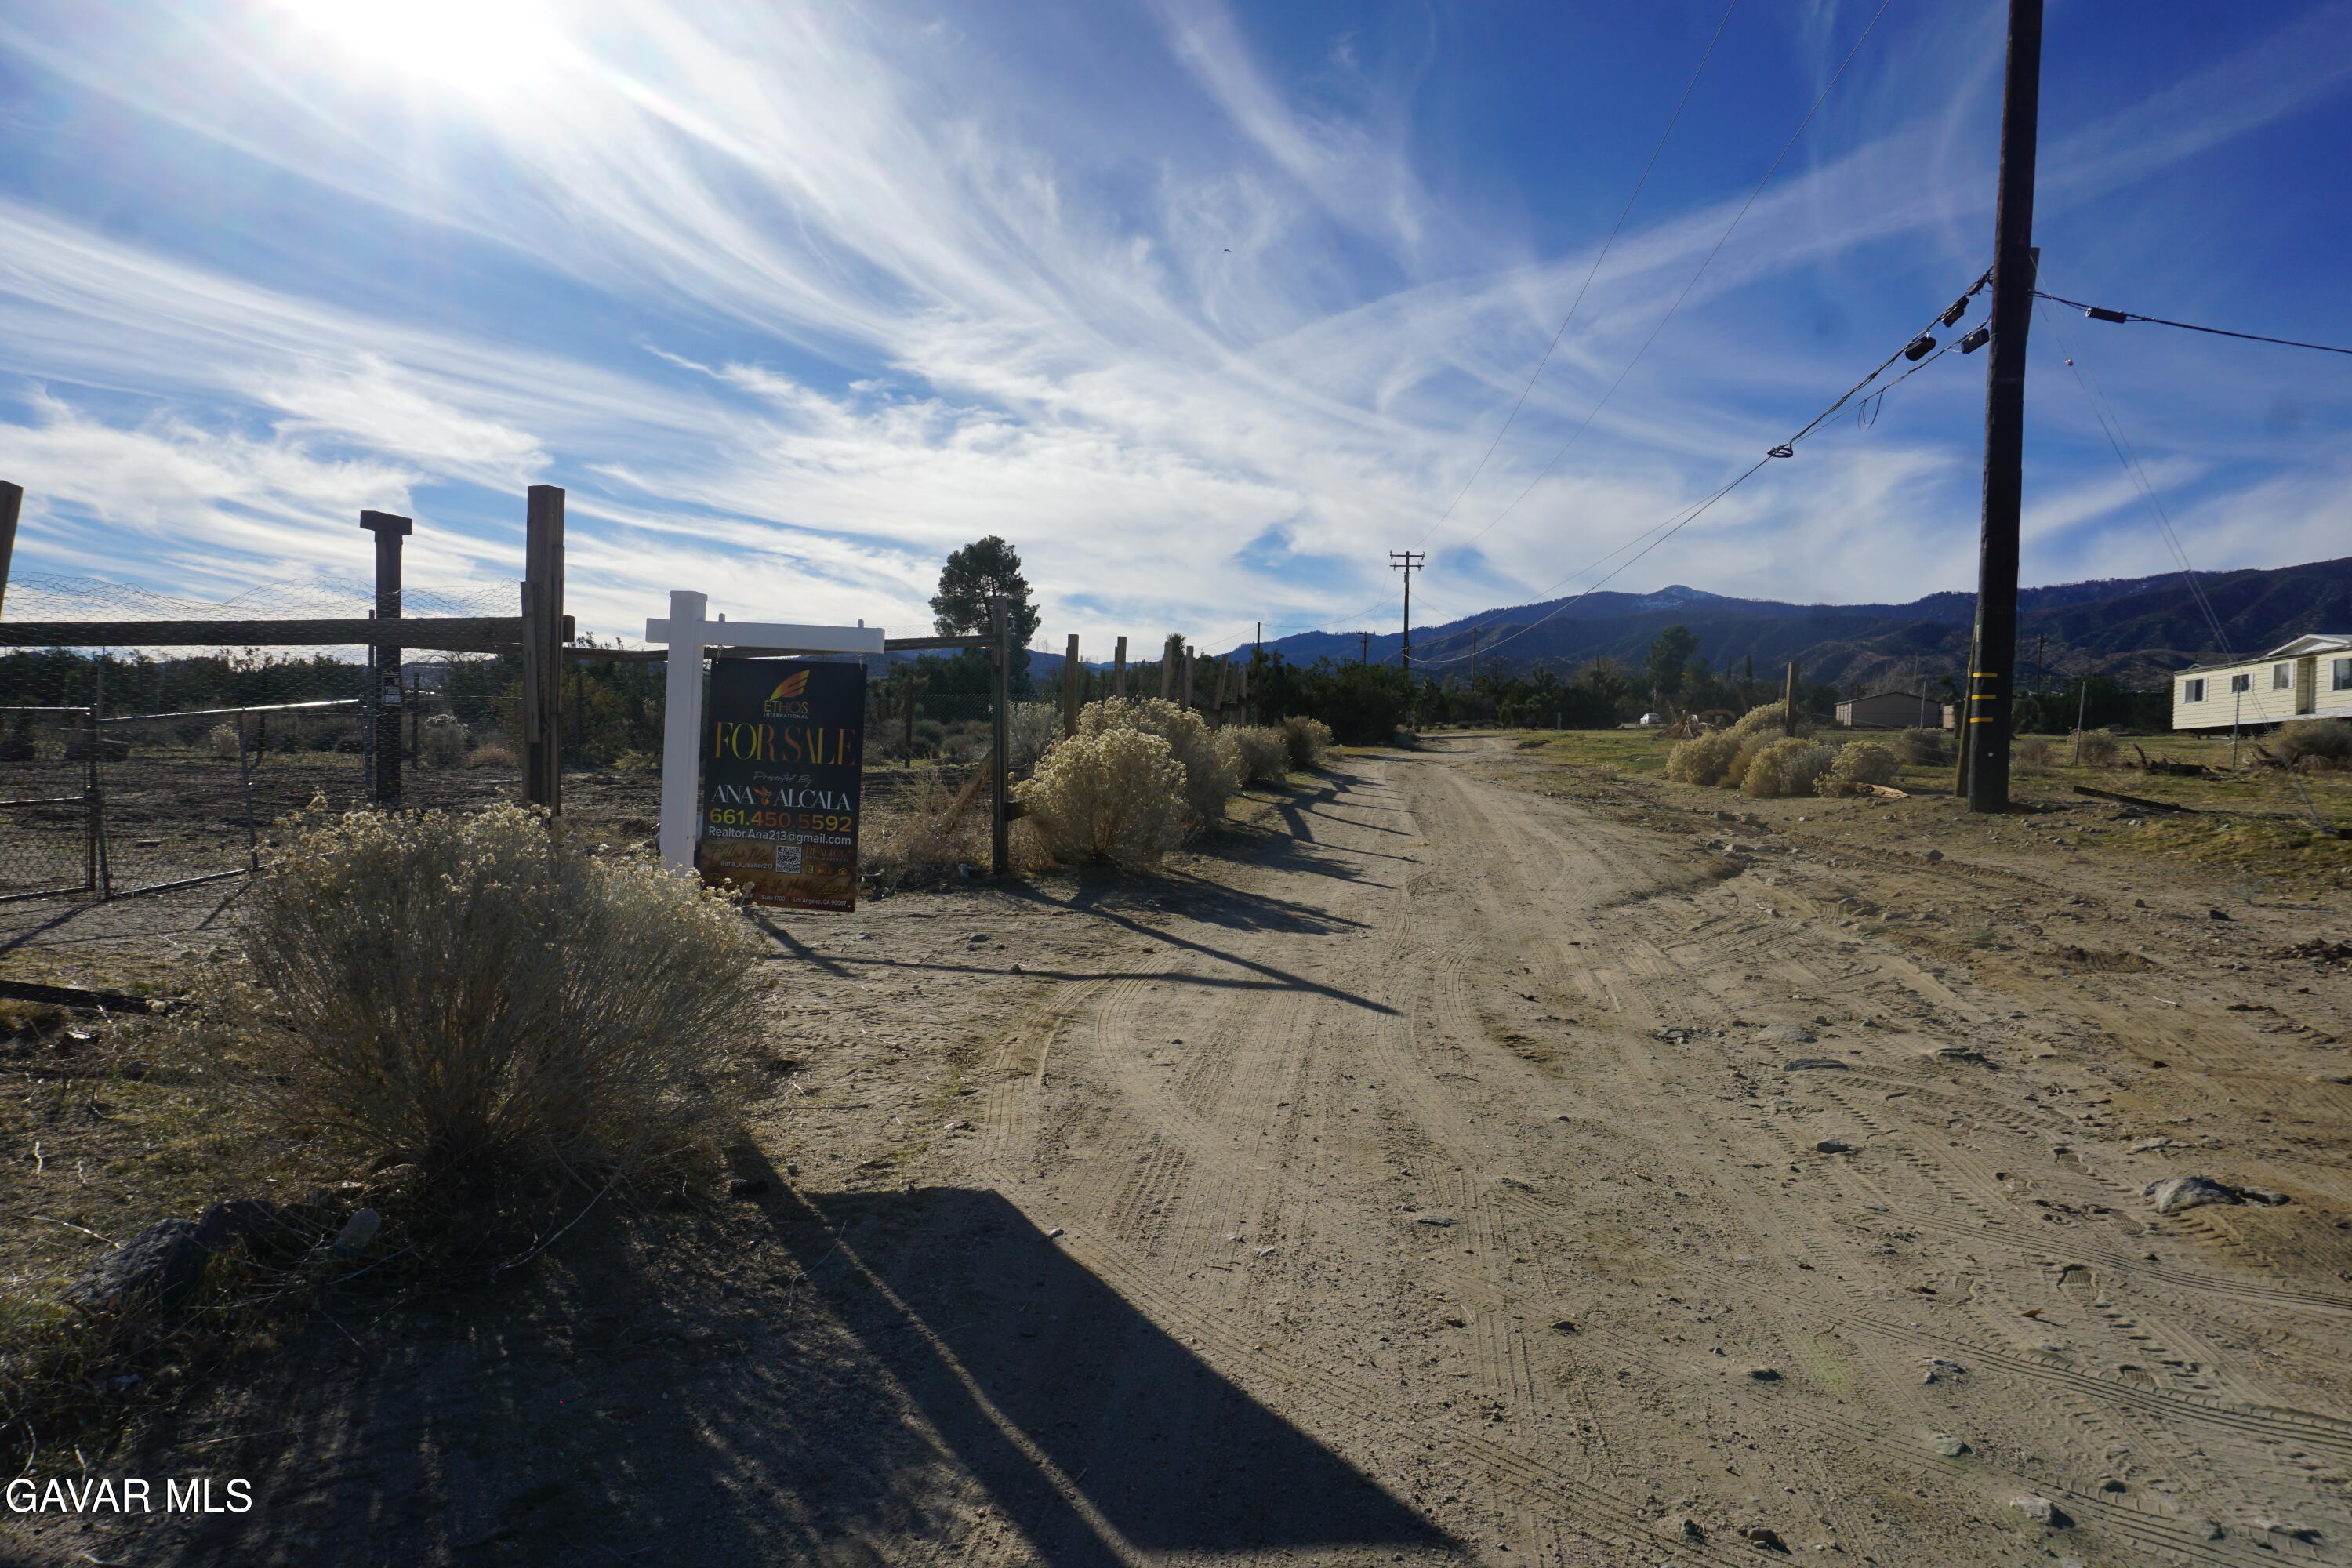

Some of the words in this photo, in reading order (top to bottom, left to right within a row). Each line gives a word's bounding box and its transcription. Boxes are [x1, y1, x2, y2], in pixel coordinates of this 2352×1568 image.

[764, 700, 809, 714] ETHOS
[715, 721, 777, 762] FOR
[783, 727, 857, 766] SALE
[710, 784, 757, 805] ANA
[773, 788, 854, 811] ALCALA
[709, 808, 852, 833] 661.450.5592
[709, 826, 851, 846] Realtor.Ana213@gmail.com
